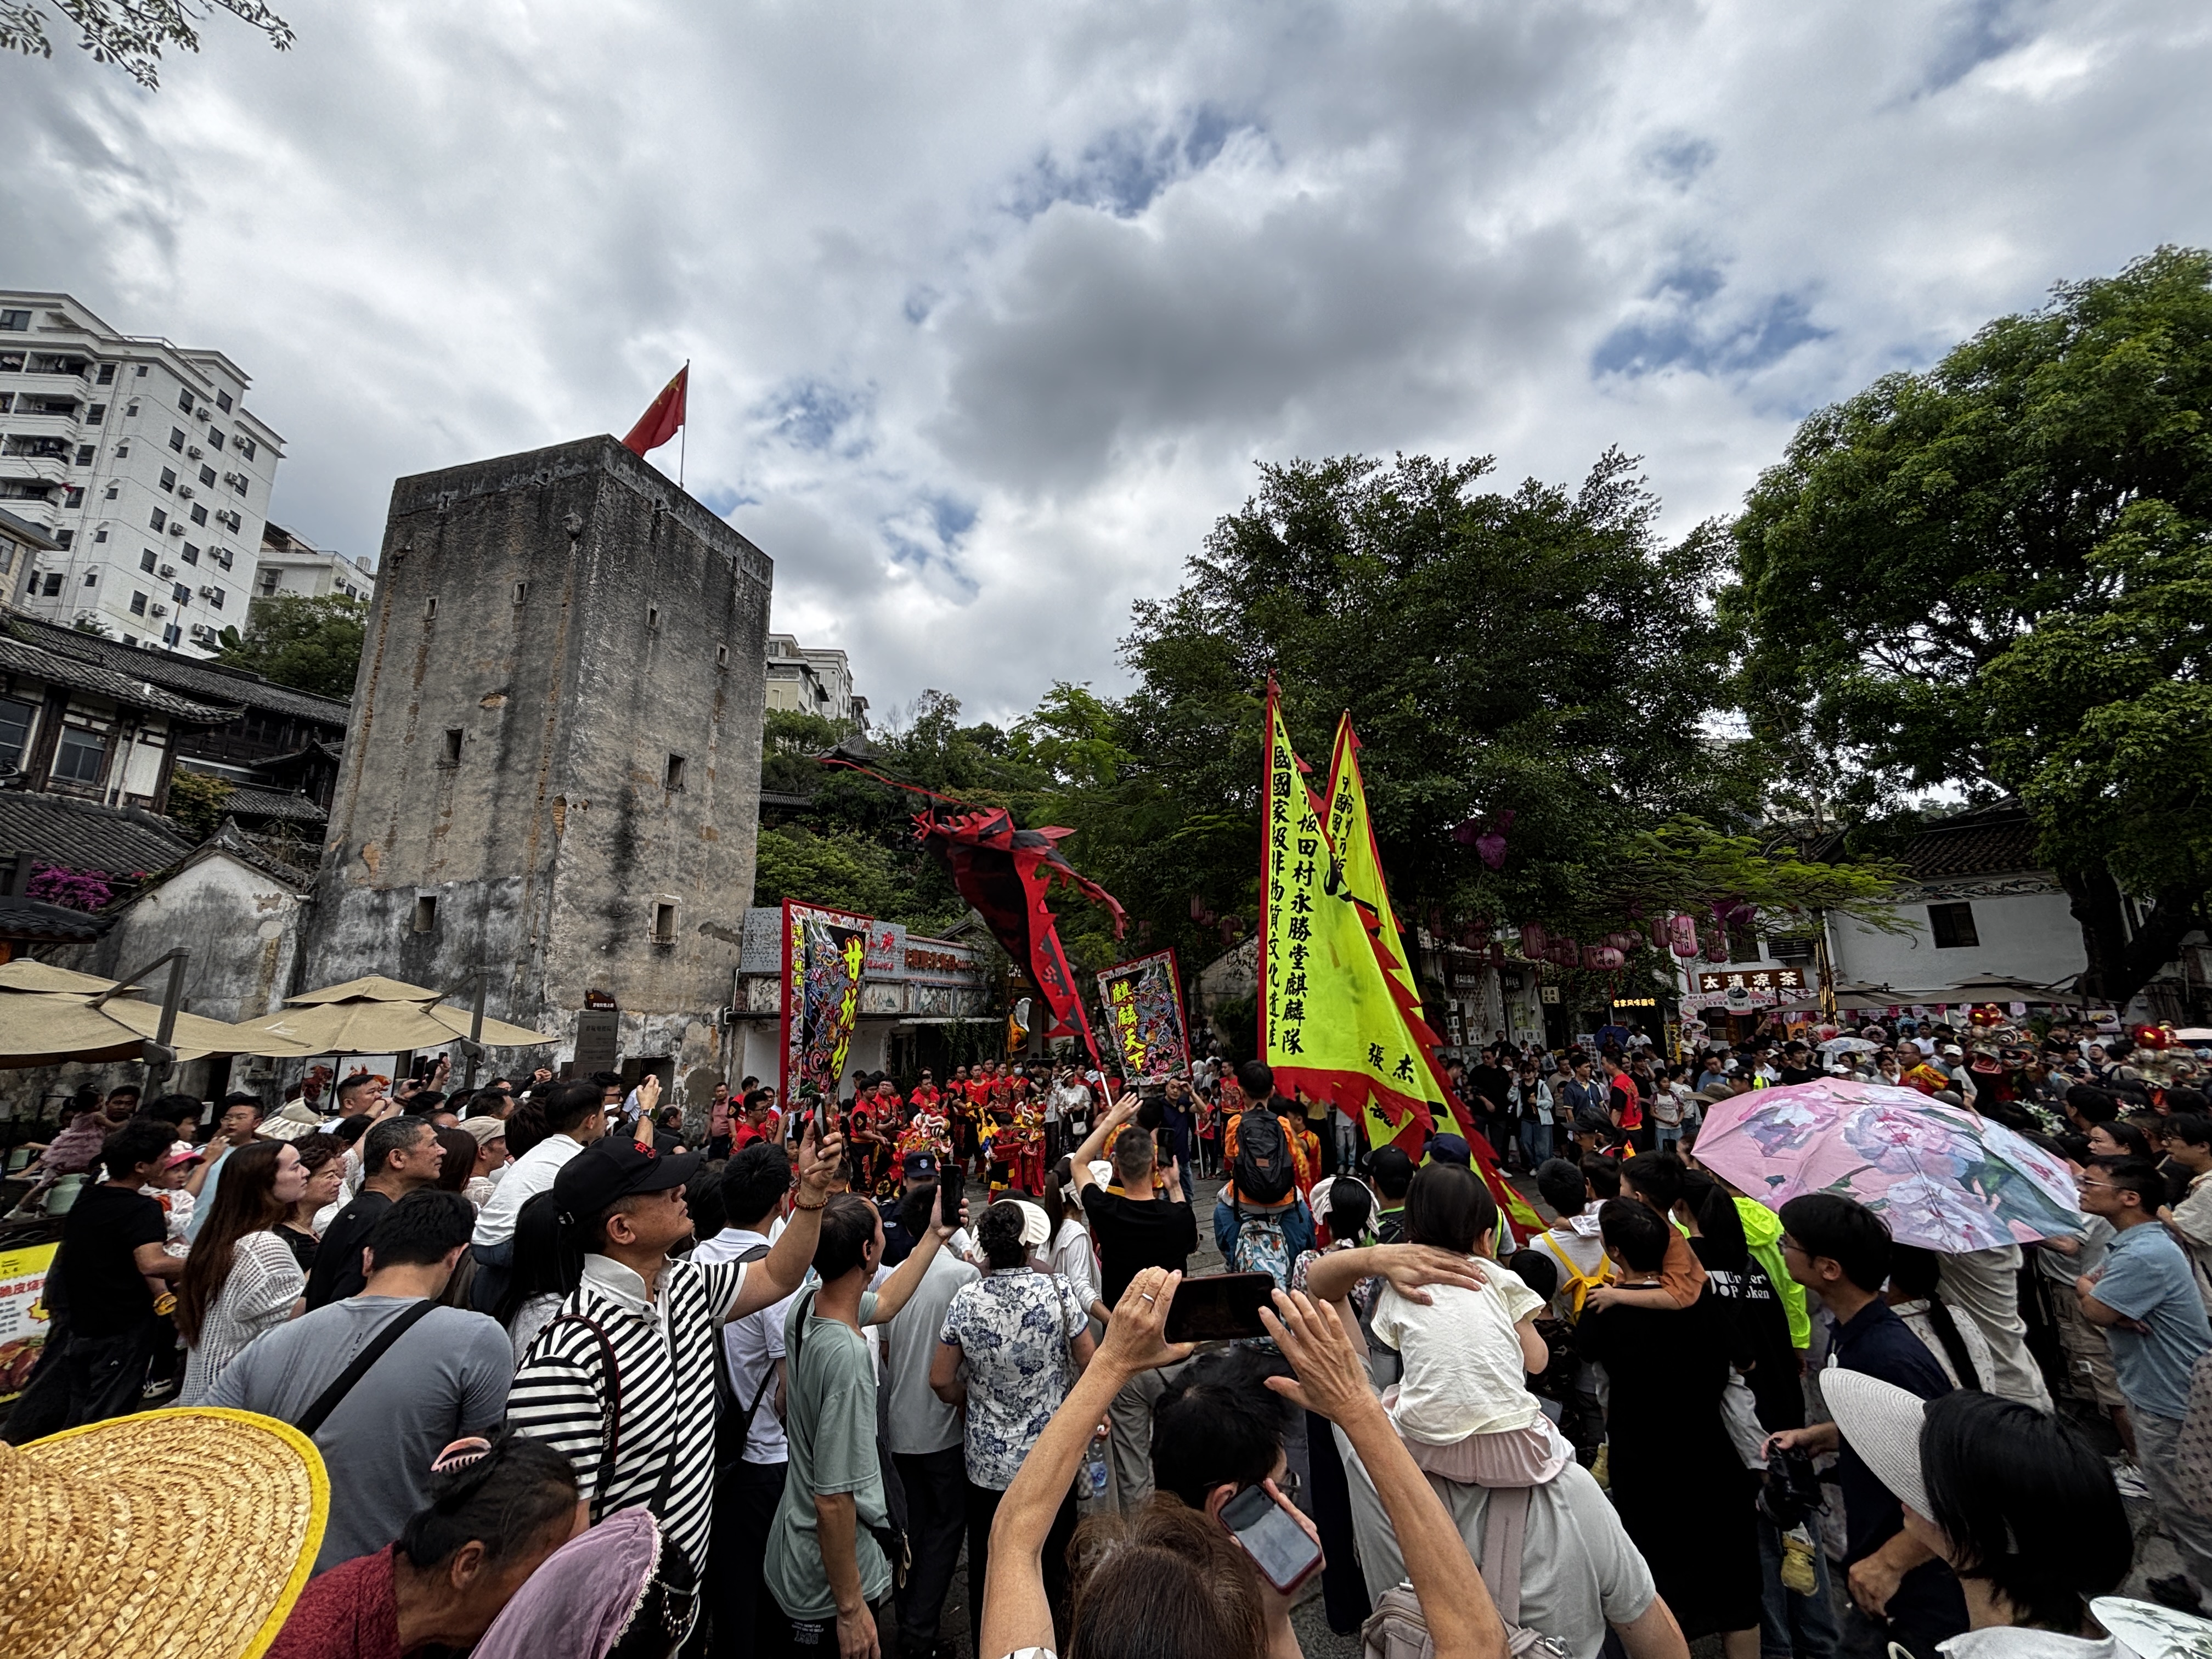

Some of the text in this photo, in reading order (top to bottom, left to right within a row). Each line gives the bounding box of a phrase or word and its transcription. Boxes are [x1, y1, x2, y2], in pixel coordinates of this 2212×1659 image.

[1703, 971, 1798, 989] 太清凉茶
[1112, 981, 1146, 1070] 麒麟天下
[1724, 1271, 1763, 1284] Uner
[603, 1401, 614, 1452] Canon
